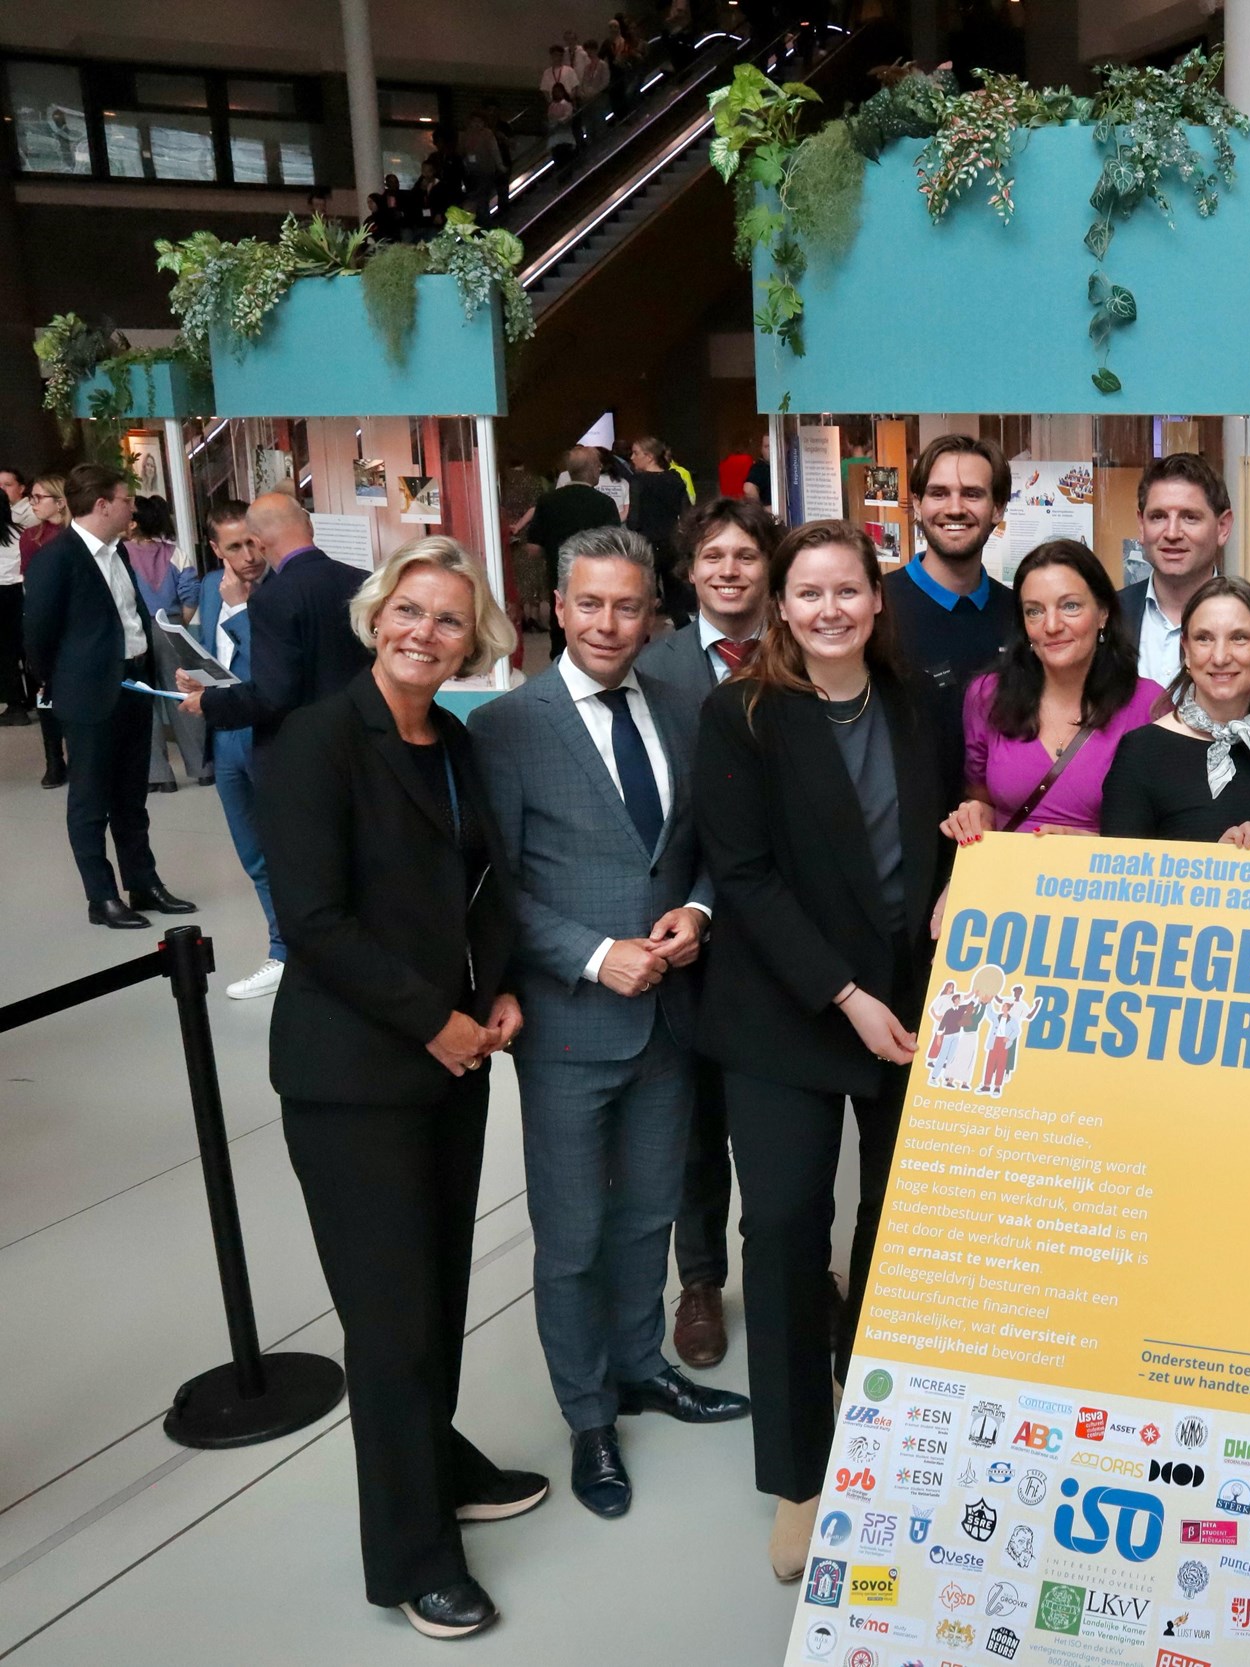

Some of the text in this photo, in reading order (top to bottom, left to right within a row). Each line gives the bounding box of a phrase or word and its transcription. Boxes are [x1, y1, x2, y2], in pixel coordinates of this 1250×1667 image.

[1089, 852, 1156, 877] maak
[1036, 872, 1184, 906] toegankelijk
[1190, 883, 1220, 906] en
[913, 1096, 1104, 1127] De medezeggenschap of een
[909, 1116, 1092, 1149] bestuursjaar bij een studie-,
[904, 1137, 1147, 1176] studenten- of sportvereniging wordt
[900, 1158, 1154, 1199] steeds minder toegankelijk door de
[896, 1177, 1148, 1220] hoge kosten en werkdruk, omdat een
[892, 1200, 1148, 1242] studentbestuur vaak onbetaald is en
[887, 1219, 1149, 1266] het door de werkdruk niet mogelijk is
[883, 1244, 1042, 1274] om ernaast te werken.
[878, 1262, 1118, 1306] Collegegeldvrij besturen maakt een
[874, 1283, 1049, 1320] bestuursfunctie financieel
[870, 1306, 1098, 1349] toegankelijker, wat diversiteit en
[865, 1326, 1066, 1368] kansengelijkheid bevordert!
[1141, 1350, 1224, 1373] Ondersteun
[1148, 1370, 1170, 1384] zet
[1174, 1375, 1195, 1387] uw
[1018, 1395, 1073, 1414] Contractus
[922, 1408, 952, 1424] ESN
[1012, 1420, 1063, 1453] ABC
[1110, 1424, 1136, 1434] ASSET
[918, 1438, 948, 1454] ESN
[912, 1470, 943, 1486] ESN
[1100, 1456, 1144, 1478] ORAS
[1217, 1500, 1250, 1514] STERK
[864, 1512, 898, 1530] SPS
[966, 1515, 992, 1530] SSRE
[1046, 1558, 1156, 1582] INTERSTEDELIJK
[1044, 1569, 1154, 1594] STUDENTEN OVERLEG
[946, 1590, 976, 1606] VSSD
[1000, 1596, 1028, 1608] GROOVER
[1083, 1618, 1146, 1636] Landelijke Kamer
[1194, 1630, 1210, 1640] VUUR
[988, 1640, 1014, 1658] BEURS
[991, 1630, 1018, 1649] KOORN
[1054, 1637, 1066, 1646] Het
[1068, 1639, 1082, 1648] ISO
[1094, 1644, 1104, 1652] de
[1082, 1629, 1145, 1648] van Verenigingen
[1029, 1643, 1100, 1664] vertegenwoordigen
